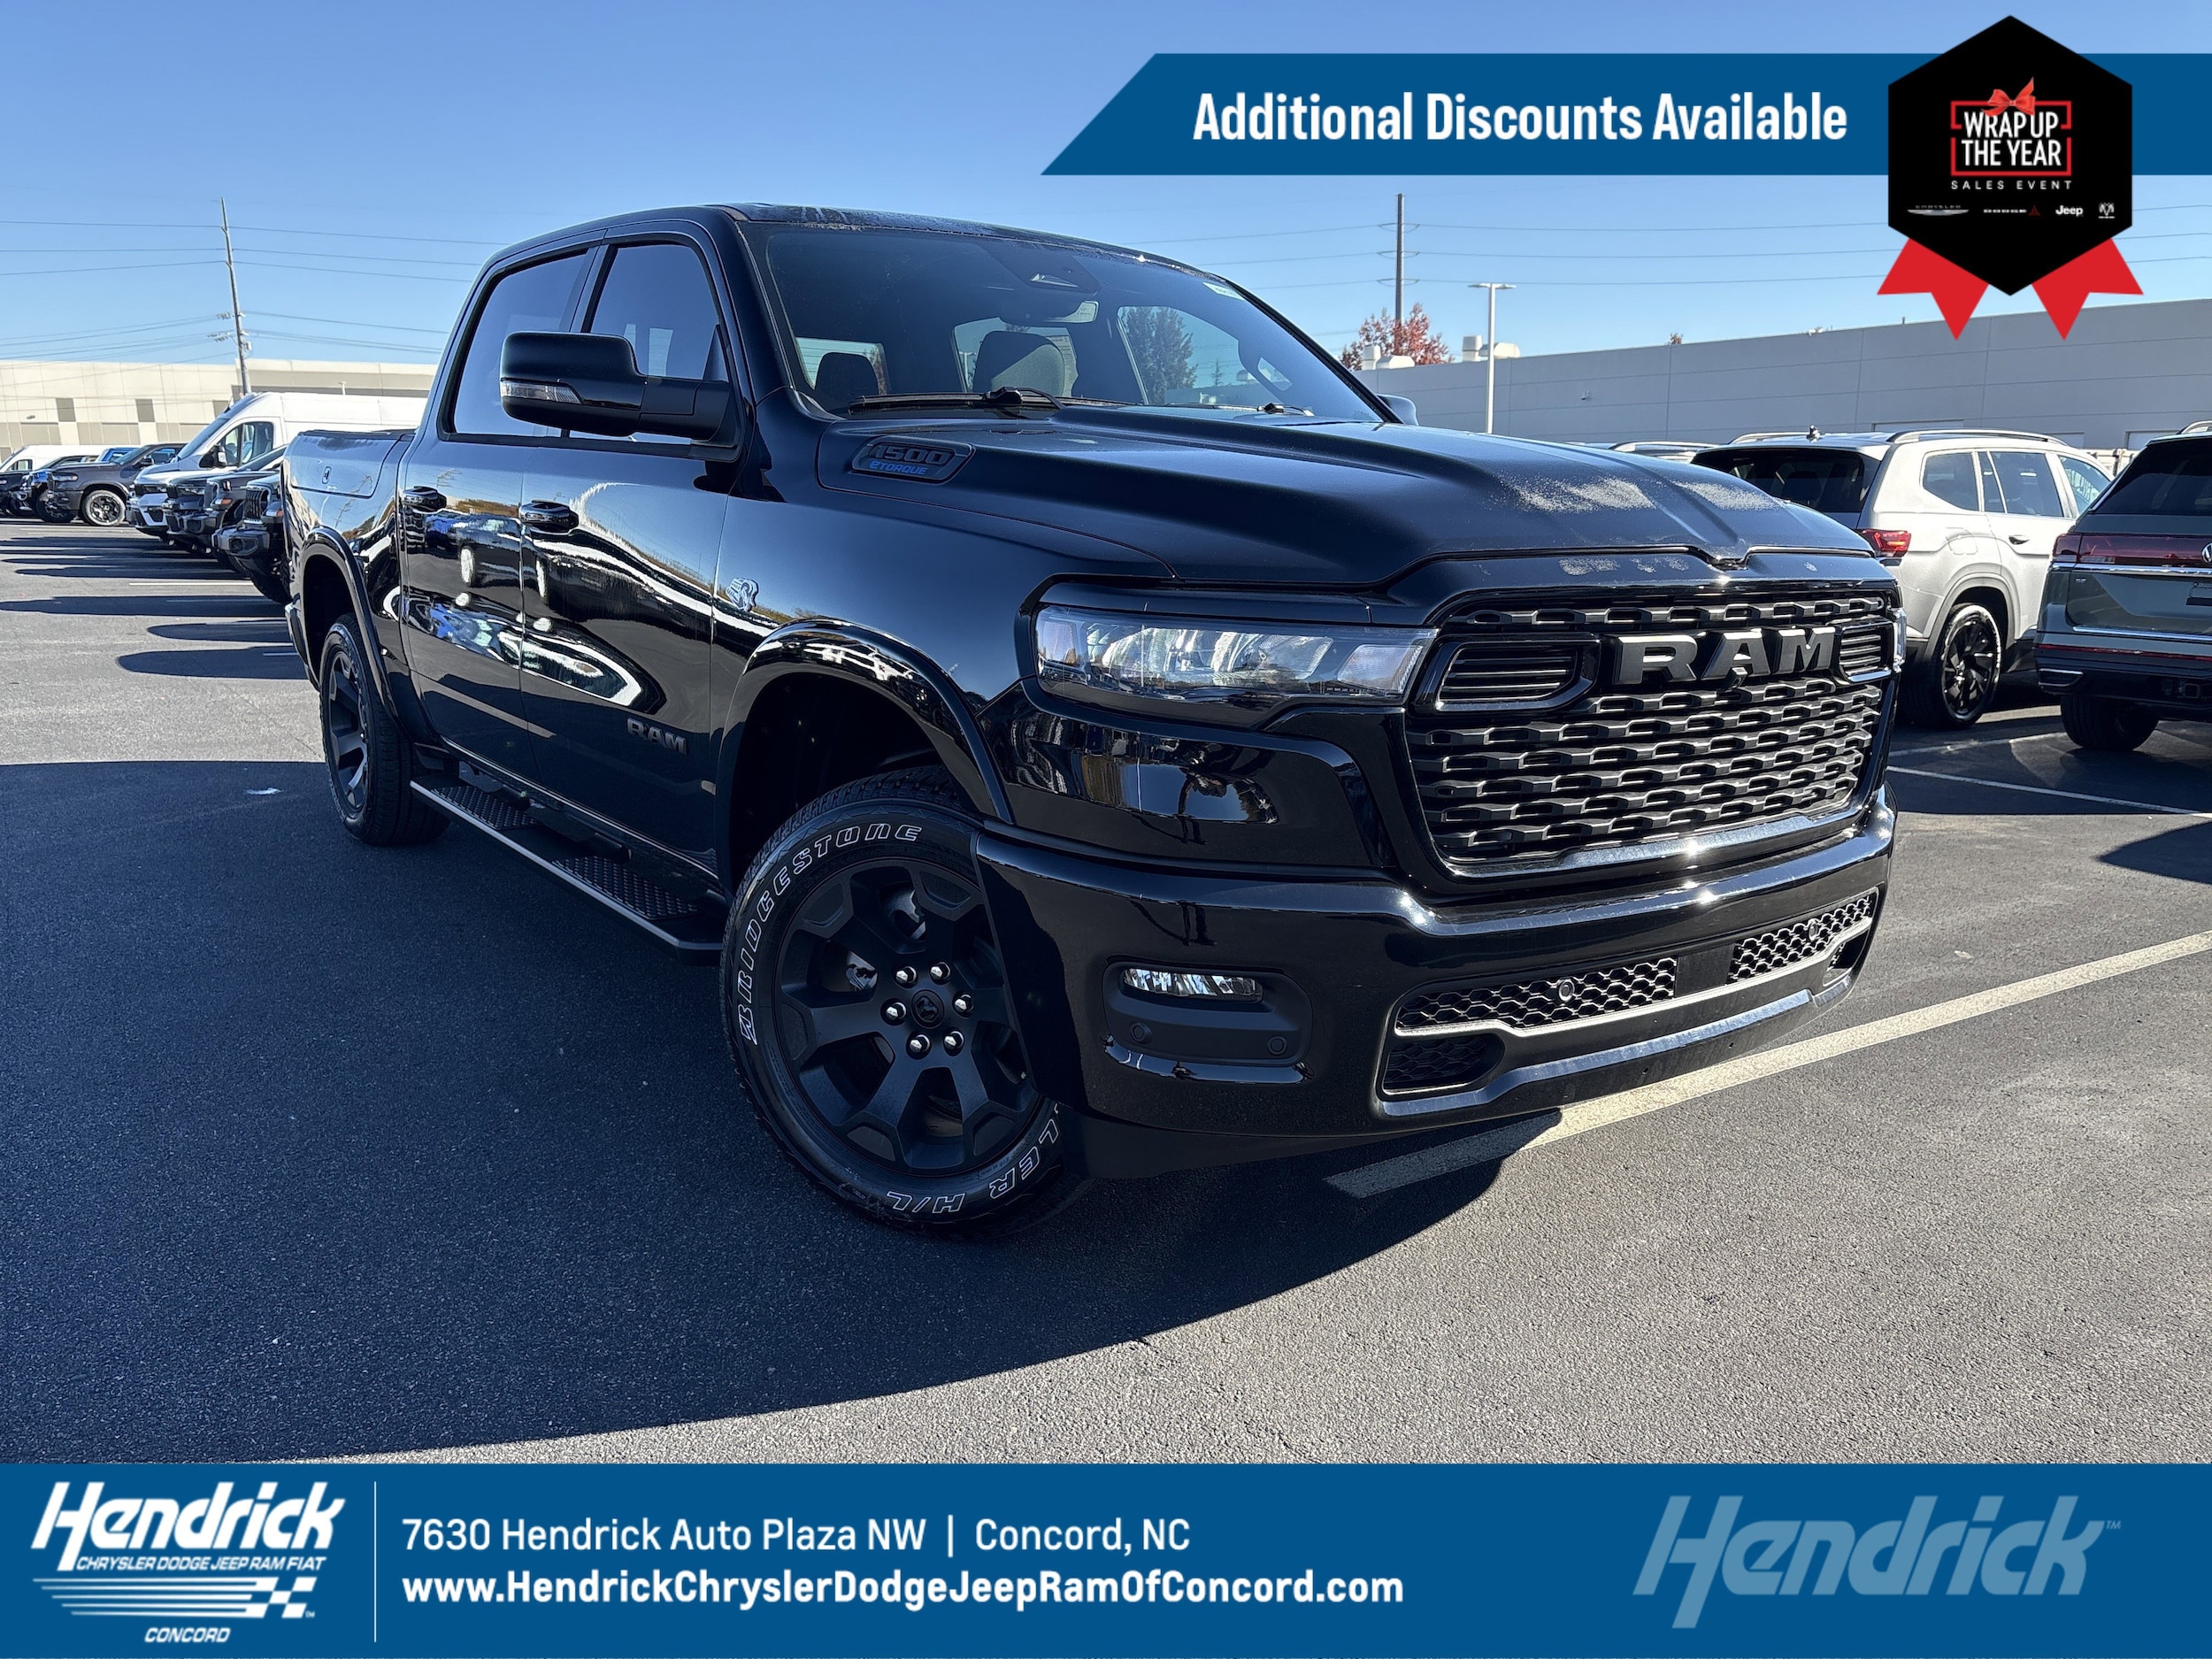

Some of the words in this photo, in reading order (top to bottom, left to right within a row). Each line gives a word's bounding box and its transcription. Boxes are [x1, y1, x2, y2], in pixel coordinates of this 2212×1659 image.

[874, 445, 950, 465] 1500
[1612, 625, 1837, 686] RAM
[626, 718, 687, 756] RAM
[737, 823, 923, 1046] BRIDGESTONE
